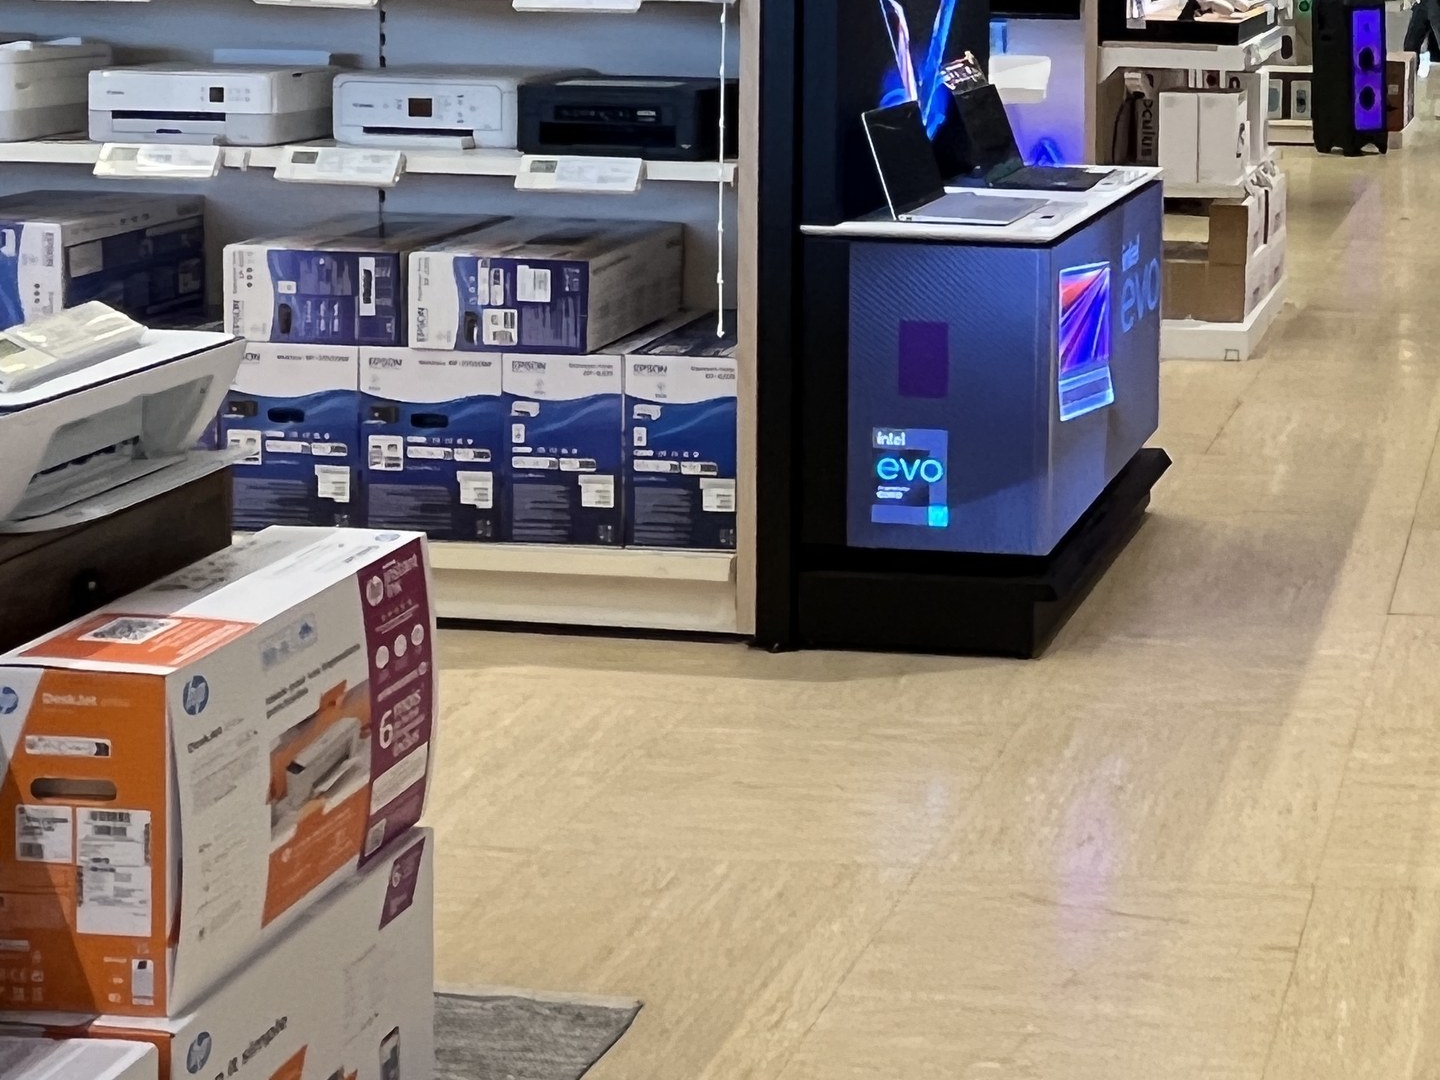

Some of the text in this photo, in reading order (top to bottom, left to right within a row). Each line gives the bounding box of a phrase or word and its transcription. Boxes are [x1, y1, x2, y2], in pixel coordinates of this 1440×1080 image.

[1121, 258, 1160, 334] evo
[876, 431, 906, 446] intel
[877, 457, 944, 483] evo
[379, 709, 393, 750] 6
